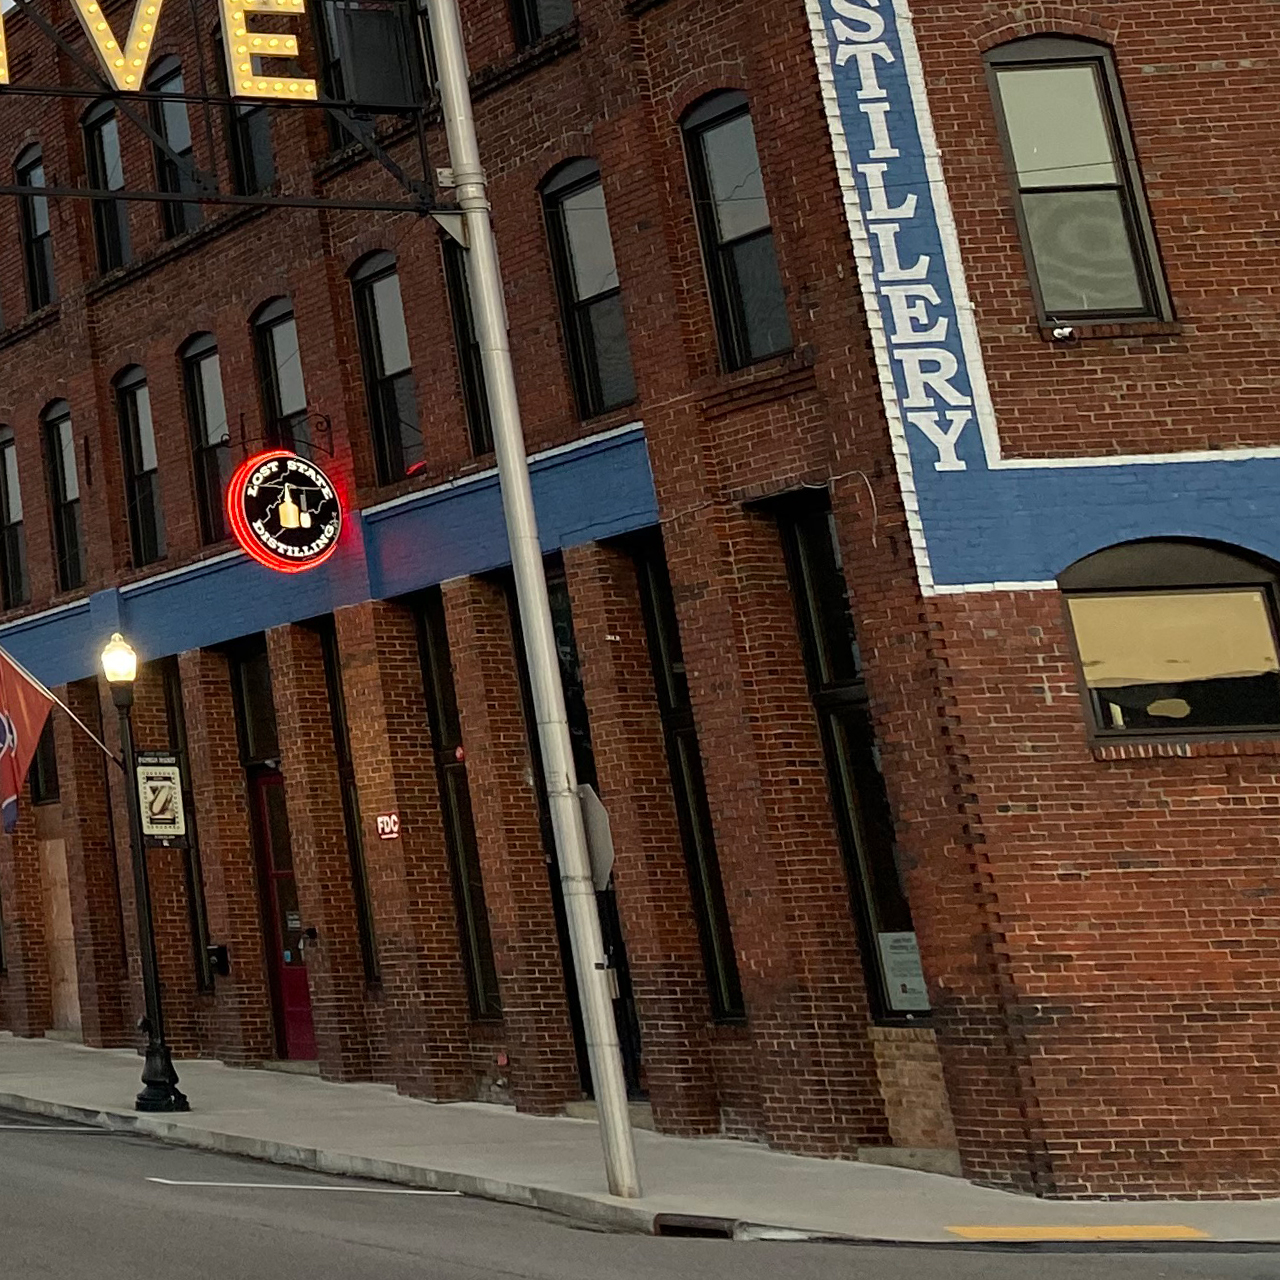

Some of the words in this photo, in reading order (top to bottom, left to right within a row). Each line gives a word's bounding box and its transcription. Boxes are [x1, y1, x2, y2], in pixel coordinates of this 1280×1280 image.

[247, 460, 279, 497] LOST
[287, 460, 333, 500] STATE
[252, 519, 337, 557] DISTILLING
[377, 814, 399, 834] FDC
